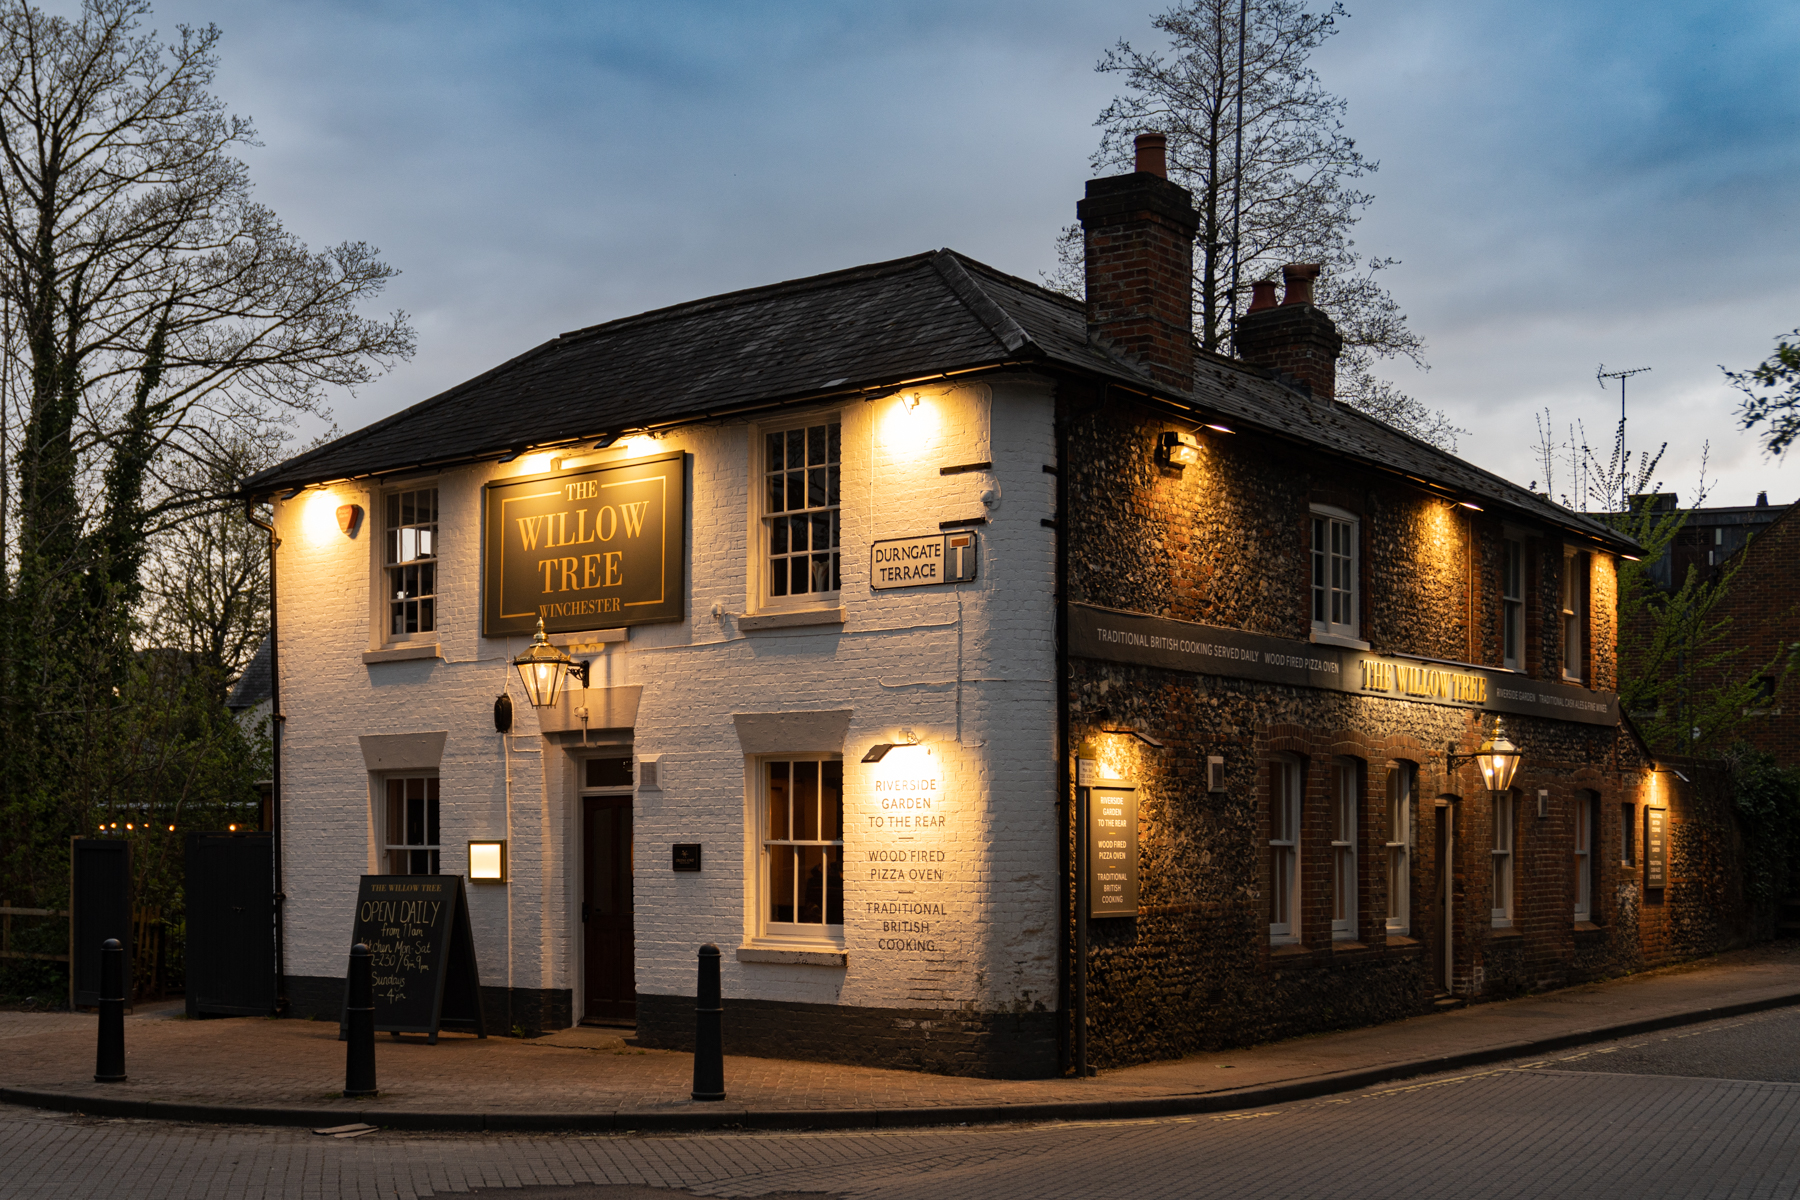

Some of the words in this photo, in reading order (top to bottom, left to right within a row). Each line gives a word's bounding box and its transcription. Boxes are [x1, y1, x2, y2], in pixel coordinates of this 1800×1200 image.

[565, 480, 598, 501] THE
[516, 501, 650, 552] WILLOW
[875, 543, 941, 563] DURNGATE
[538, 551, 623, 594] TREE
[880, 563, 936, 582] TERRACE
[539, 597, 621, 619] WINCHESTER
[1097, 628, 1149, 648] TRADITIONAL
[1150, 636, 1179, 651] BRITISH
[1180, 639, 1213, 656] COOKING
[1213, 646, 1240, 660] SERVED
[1240, 649, 1259, 663] DAILY
[1264, 653, 1285, 666] WOOD
[1285, 656, 1303, 669] FIRED
[1304, 659, 1322, 672] PIZZA
[1322, 661, 1339, 674] OVEN
[1361, 658, 1393, 691] THE
[1396, 664, 1452, 698] WILLOW
[1453, 673, 1488, 703] TREE
[875, 779, 937, 791] RIVERSIDE
[881, 798, 931, 809] GARDEN
[1100, 796, 1124, 805] RIVERSIDE
[1102, 808, 1122, 816] GARDEN
[868, 816, 884, 828] TO
[888, 816, 911, 827] THE
[915, 815, 945, 827] REAR
[1097, 819, 1105, 827] TO
[1105, 819, 1115, 827] THE
[1115, 819, 1127, 828] REAR
[1098, 840, 1113, 849] WOOD
[1113, 840, 1127, 849] FIRED
[868, 850, 907, 862] WOOD
[910, 850, 945, 862] FIRED
[1098, 851, 1113, 860] PIZZA
[1112, 851, 1126, 860] OVEN
[870, 869, 905, 880] PIZZA
[908, 869, 943, 880] OVEN
[1097, 873, 1128, 881] TRADITIONAL
[371, 884, 387, 892] THE
[388, 884, 420, 892] WILLOW
[421, 884, 442, 892] TREE
[1103, 884, 1122, 892] BRITISH
[1101, 895, 1124, 904] COOKING
[361, 900, 396, 923] OPEN
[399, 900, 441, 928] DAILY
[866, 902, 948, 916] TRADITIONAL
[381, 922, 400, 939] from
[402, 922, 423, 938] 11am
[883, 921, 930, 933] BRITISH
[360, 937, 392, 954] Ktchen
[878, 938, 936, 951] COOKING
[371, 971, 405, 992] Sundays
